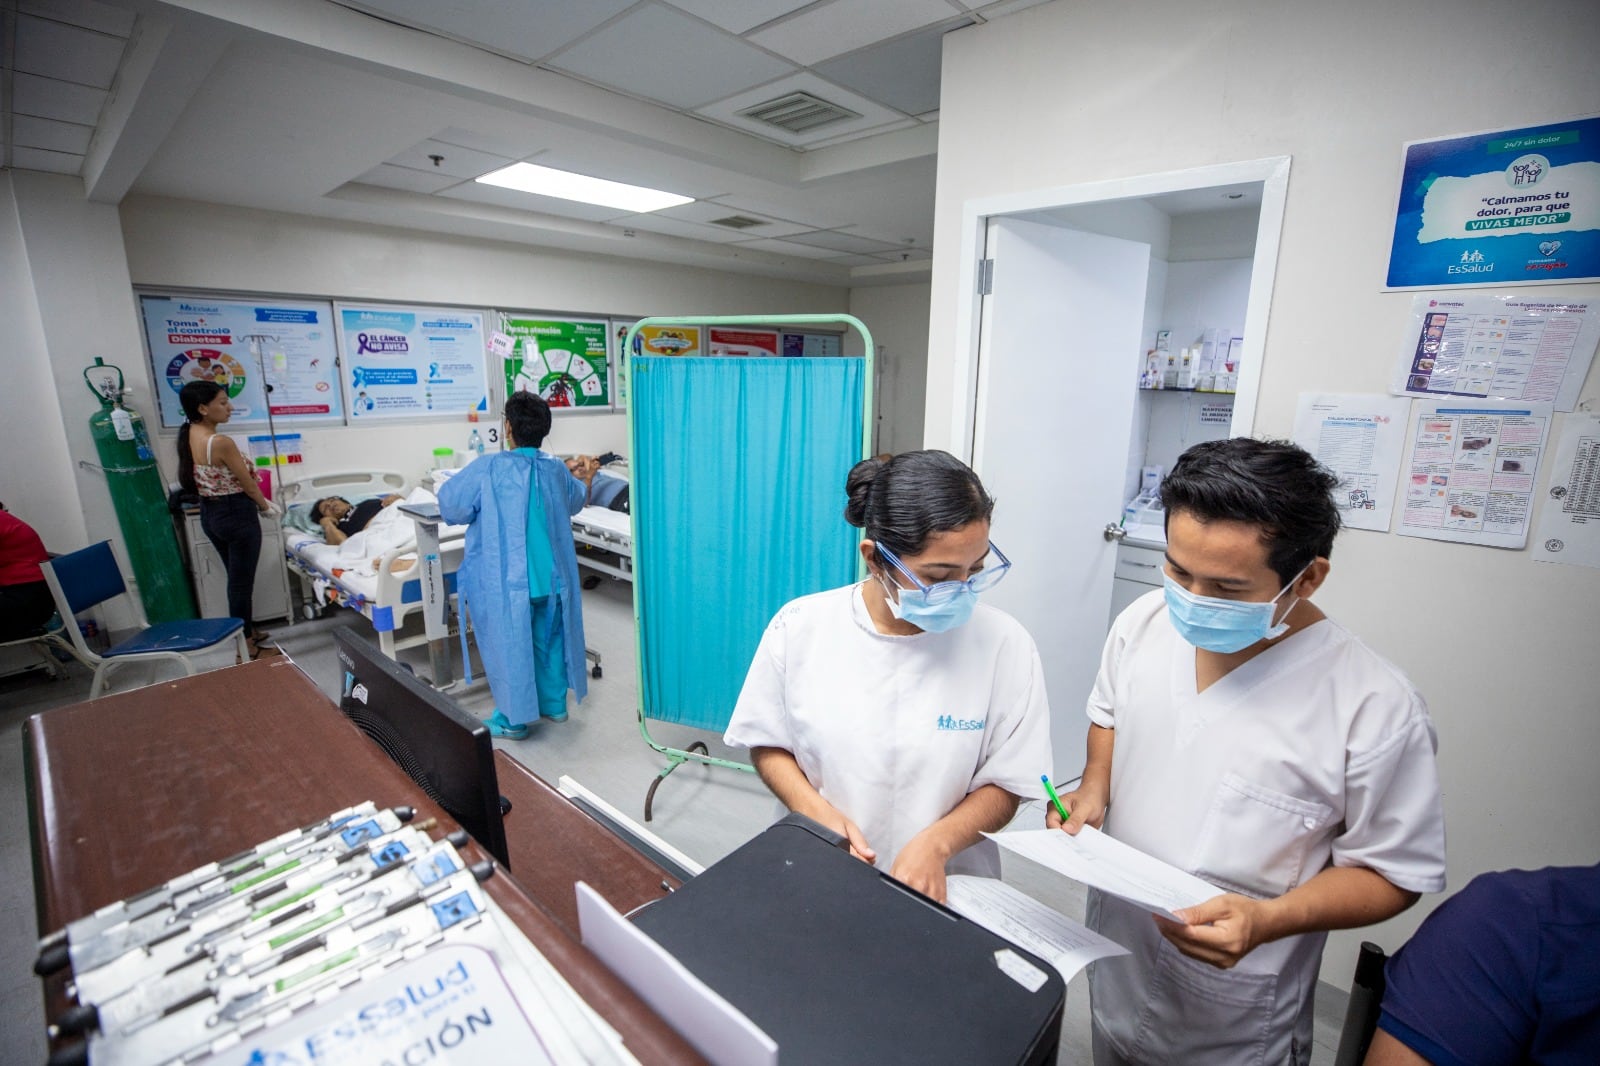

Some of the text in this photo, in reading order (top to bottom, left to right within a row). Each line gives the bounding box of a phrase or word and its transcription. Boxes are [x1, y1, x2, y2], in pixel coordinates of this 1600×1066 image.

[1503, 136, 1561, 149] 24/7 sin dolor
[1481, 190, 1571, 207] “Calmamos tu
[1476, 201, 1571, 218] dolor, para que
[1471, 212, 1566, 231] VIVAS MEJOR”
[1447, 262, 1495, 275] EsSalud
[166, 319, 199, 328] Toma
[167, 326, 221, 335] el control
[170, 335, 222, 344] Diabetes
[379, 333, 407, 342] CÁNCER
[370, 342, 408, 351] NO AVISA
[488, 428, 499, 443] 3
[304, 960, 470, 1060] EsSalud
[380, 1007, 493, 1066] CIÓN
